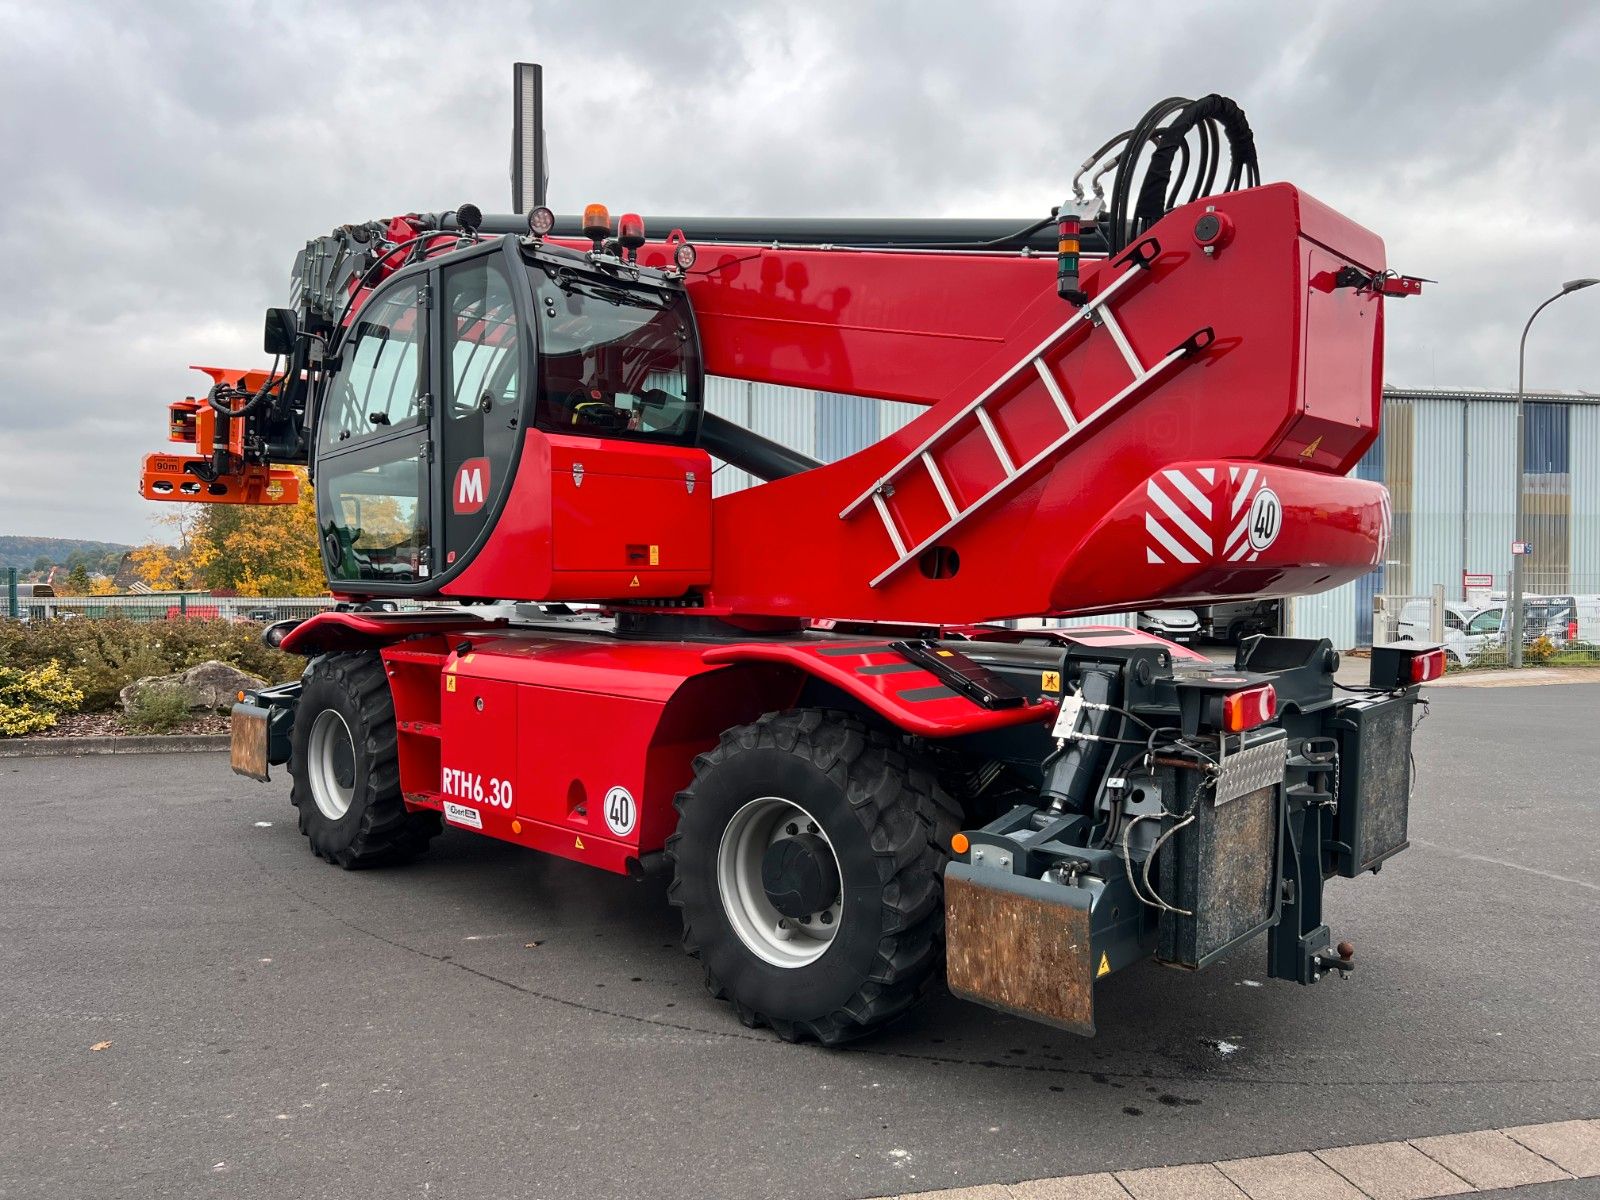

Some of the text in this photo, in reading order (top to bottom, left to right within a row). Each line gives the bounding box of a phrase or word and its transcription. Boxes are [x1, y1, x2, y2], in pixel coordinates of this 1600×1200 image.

[157, 462, 177, 470] 90m
[459, 468, 483, 503] M
[1254, 500, 1275, 539] 40
[443, 767, 513, 809] RTH6.30
[610, 795, 628, 827] 40
